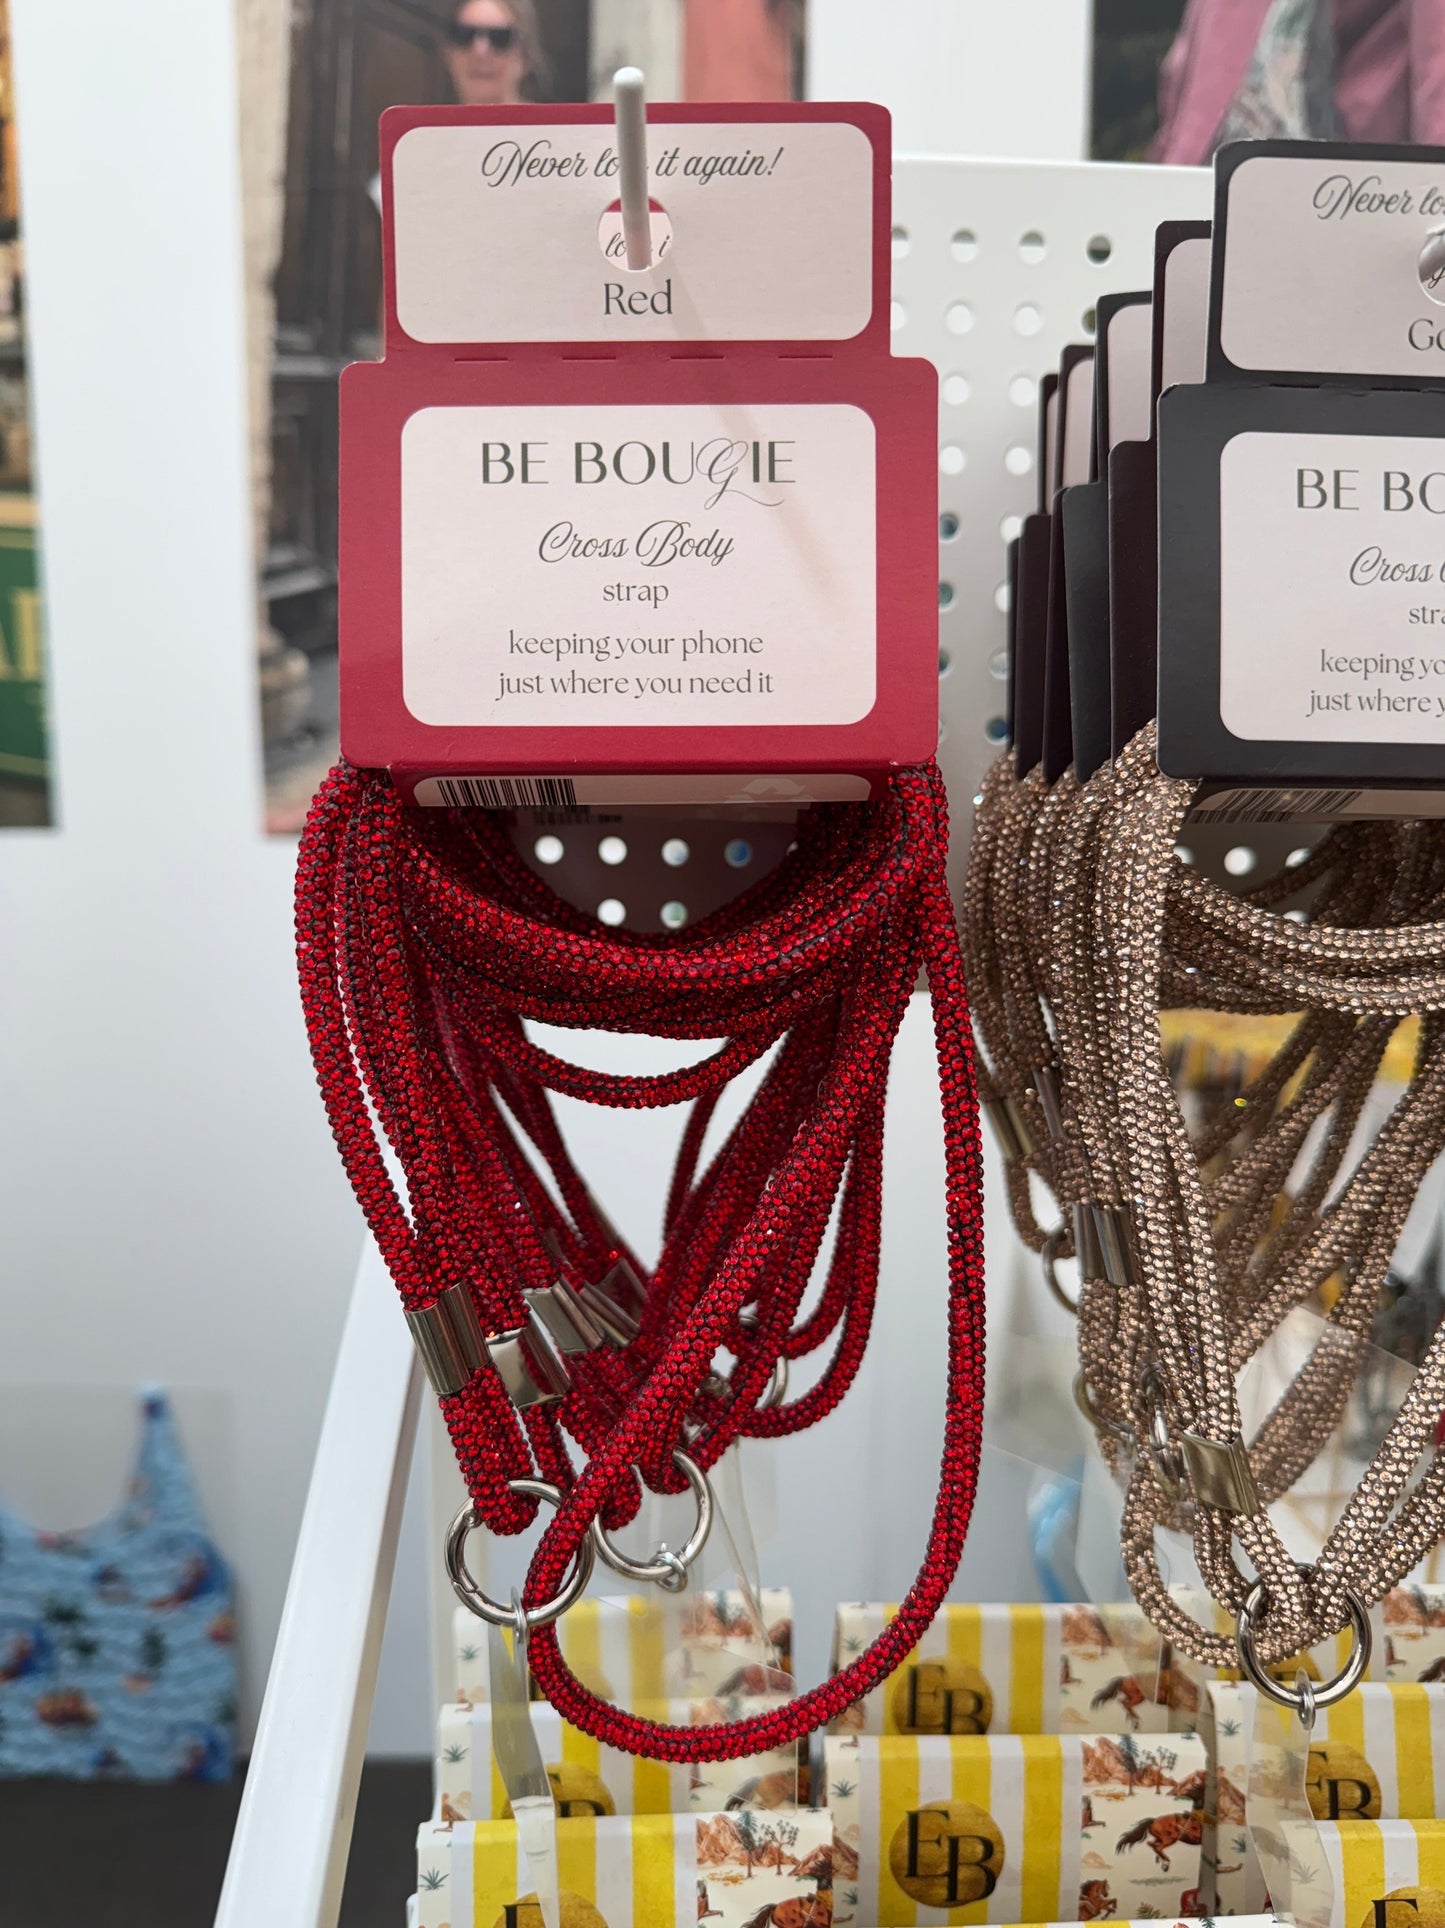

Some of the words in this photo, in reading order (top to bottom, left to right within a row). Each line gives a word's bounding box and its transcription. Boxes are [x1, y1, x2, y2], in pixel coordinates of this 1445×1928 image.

[481, 140, 588, 187] Never
[655, 147, 681, 177] it
[683, 147, 784, 186] again!
[1312, 174, 1414, 220] Never
[604, 278, 673, 315] Red
[482, 441, 549, 485] BE
[574, 438, 796, 510] BOUGIE
[1297, 468, 1360, 511] BE
[538, 521, 629, 563] Cross
[635, 520, 735, 567] Body
[1350, 546, 1433, 586] Cross
[602, 582, 669, 608] strap
[509, 630, 611, 661] keeping
[615, 636, 675, 659] your
[682, 630, 764, 661] phone
[1320, 649, 1415, 682] keeping
[495, 672, 544, 701] just
[550, 669, 629, 694] where
[634, 677, 682, 698] you
[689, 669, 752, 694] need
[758, 672, 774, 694] it
[1306, 690, 1352, 717] just
[1358, 688, 1431, 713] where
[905, 1810, 997, 1902] EB
